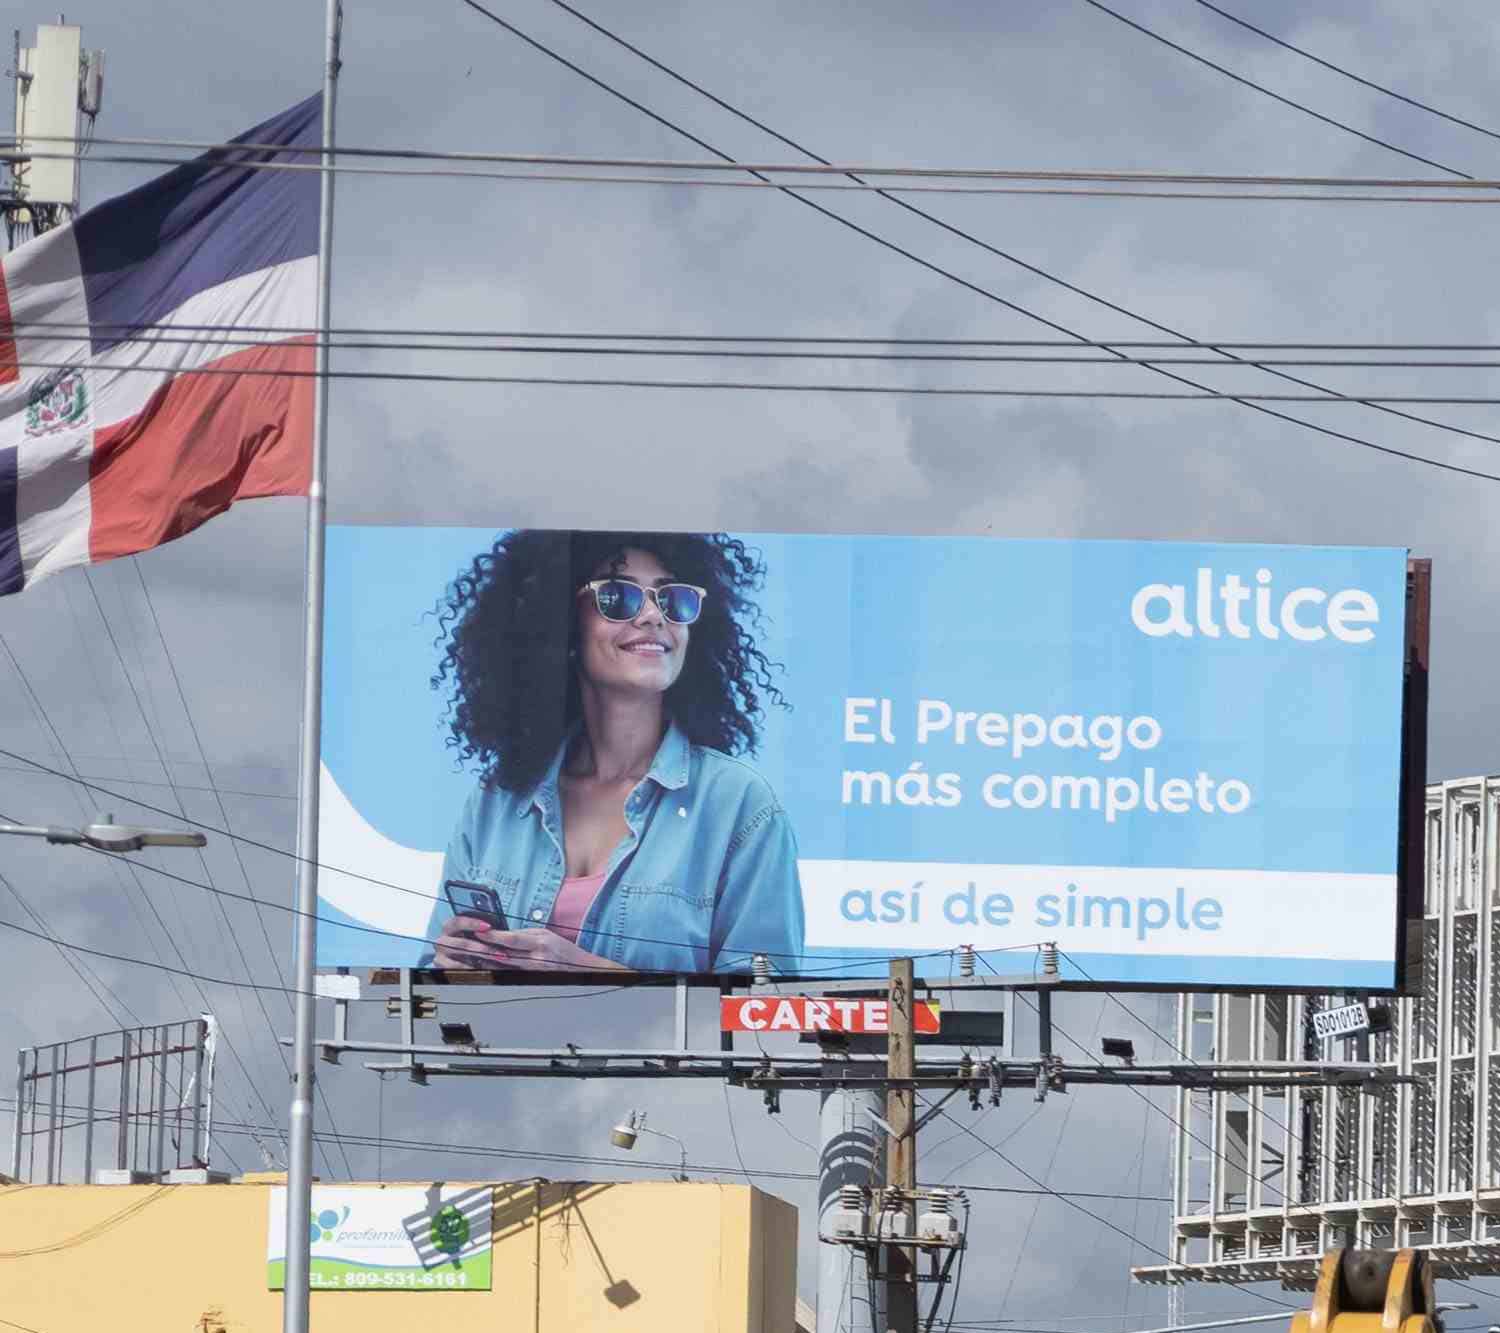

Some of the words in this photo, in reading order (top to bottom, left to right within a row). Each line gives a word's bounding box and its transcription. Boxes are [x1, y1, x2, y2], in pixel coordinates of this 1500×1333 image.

[1131, 567, 1380, 642] altice
[843, 697, 896, 744] El
[916, 699, 1162, 761] Prepago
[842, 762, 962, 808] más
[982, 767, 1251, 823] completo
[839, 880, 924, 924] así
[942, 882, 1015, 927] de
[1035, 883, 1224, 941] simple
[738, 1000, 890, 1031] CARTE
[308, 1272, 339, 1286] EL.:
